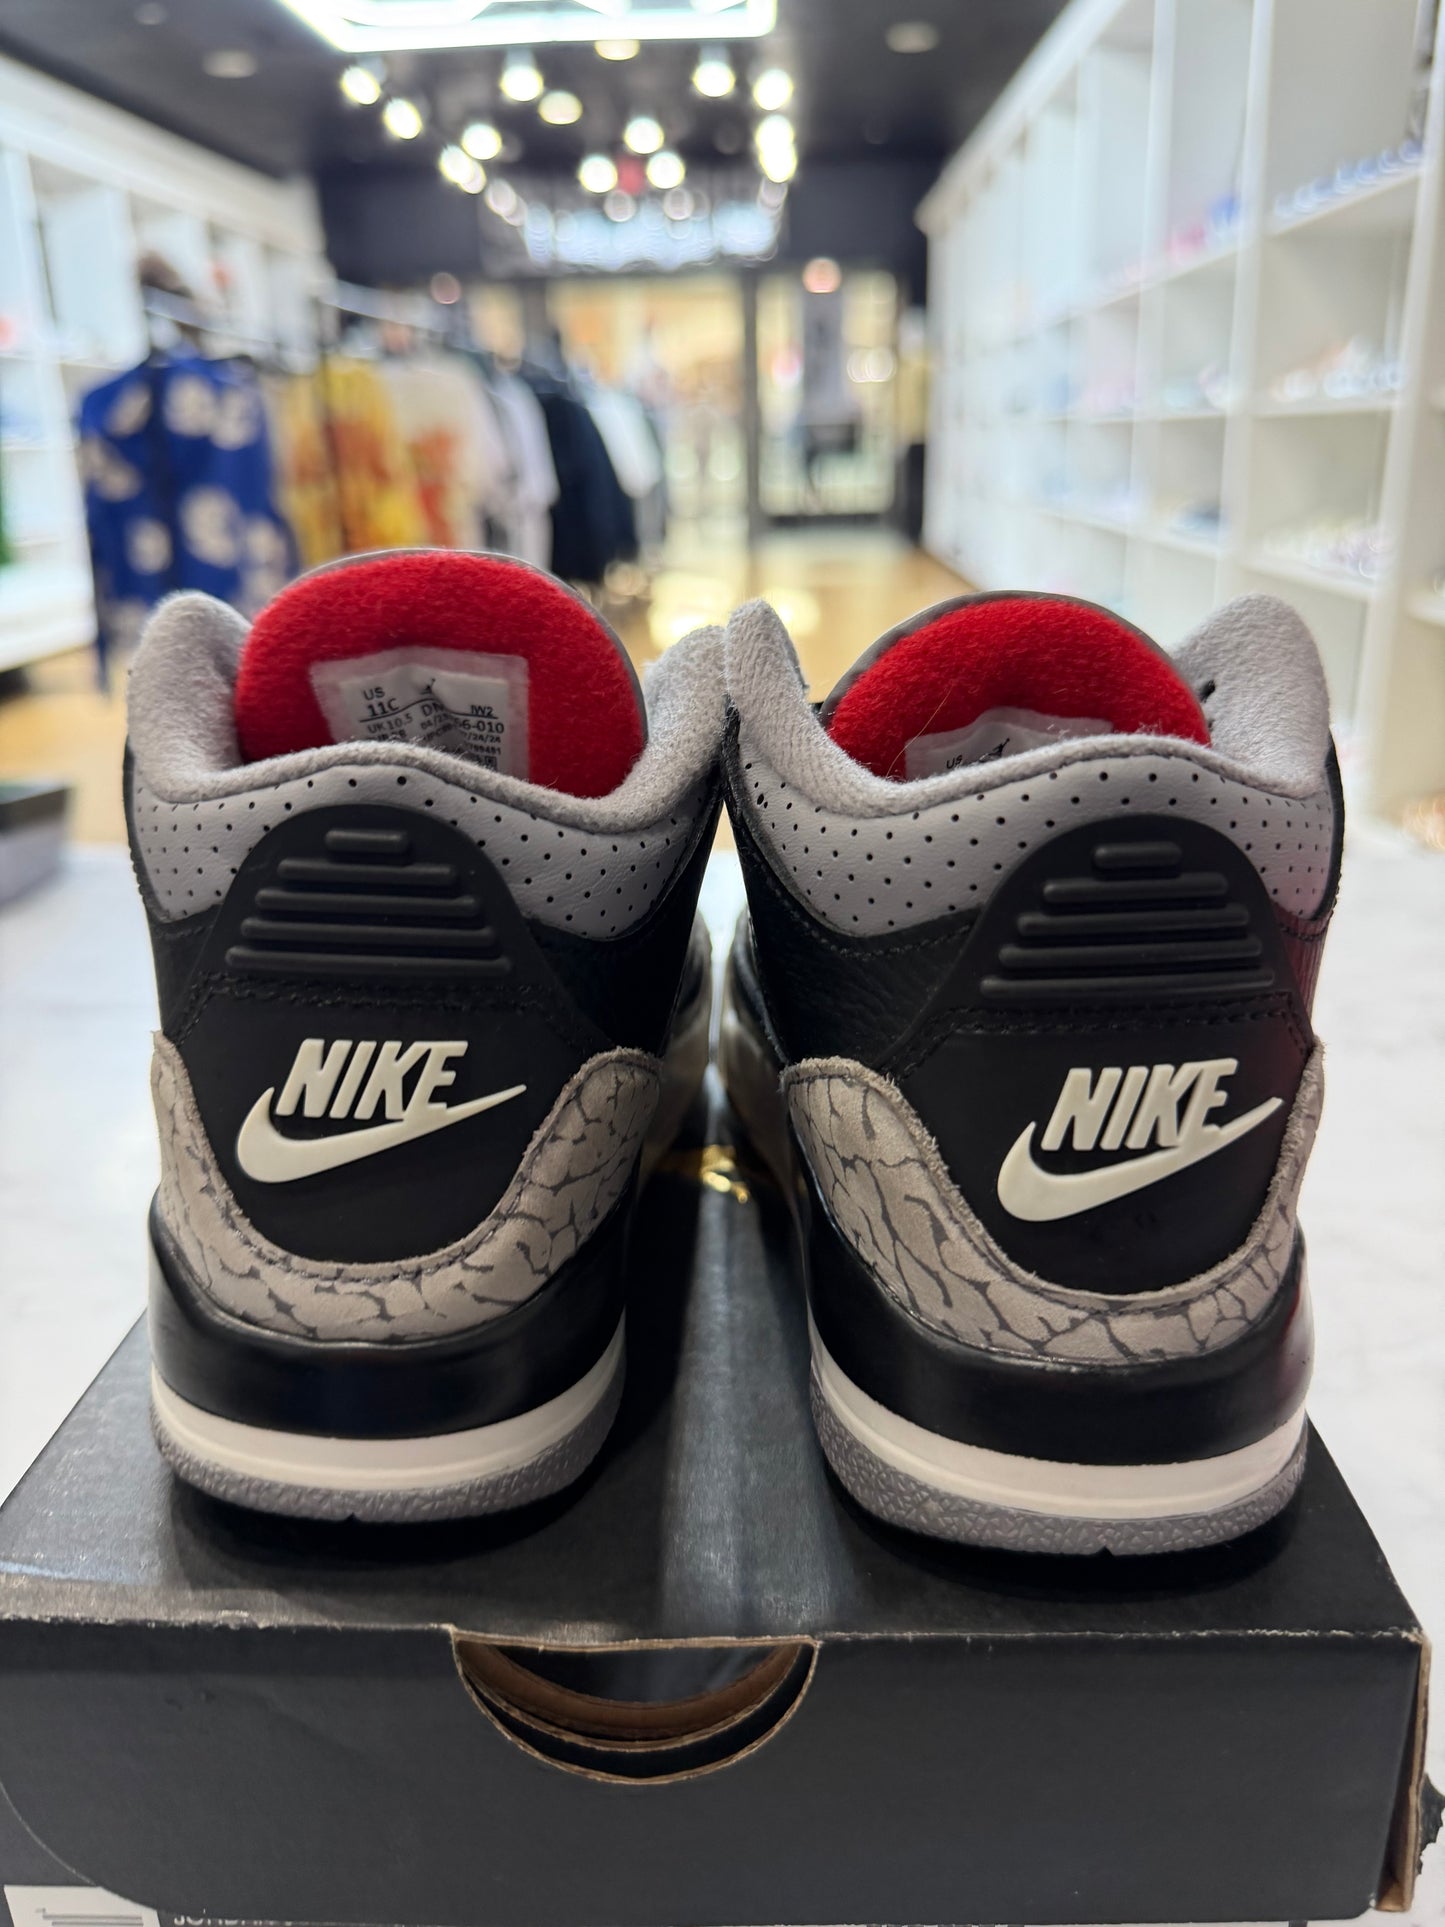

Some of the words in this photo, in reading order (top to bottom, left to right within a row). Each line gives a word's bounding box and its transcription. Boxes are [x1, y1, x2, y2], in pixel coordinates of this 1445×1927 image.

[363, 686, 385, 701] US
[367, 698, 399, 717] 11C
[367, 723, 385, 734] UK
[946, 754, 963, 769] US
[275, 1038, 469, 1121] NIKE
[1040, 1057, 1239, 1150] NIKE
